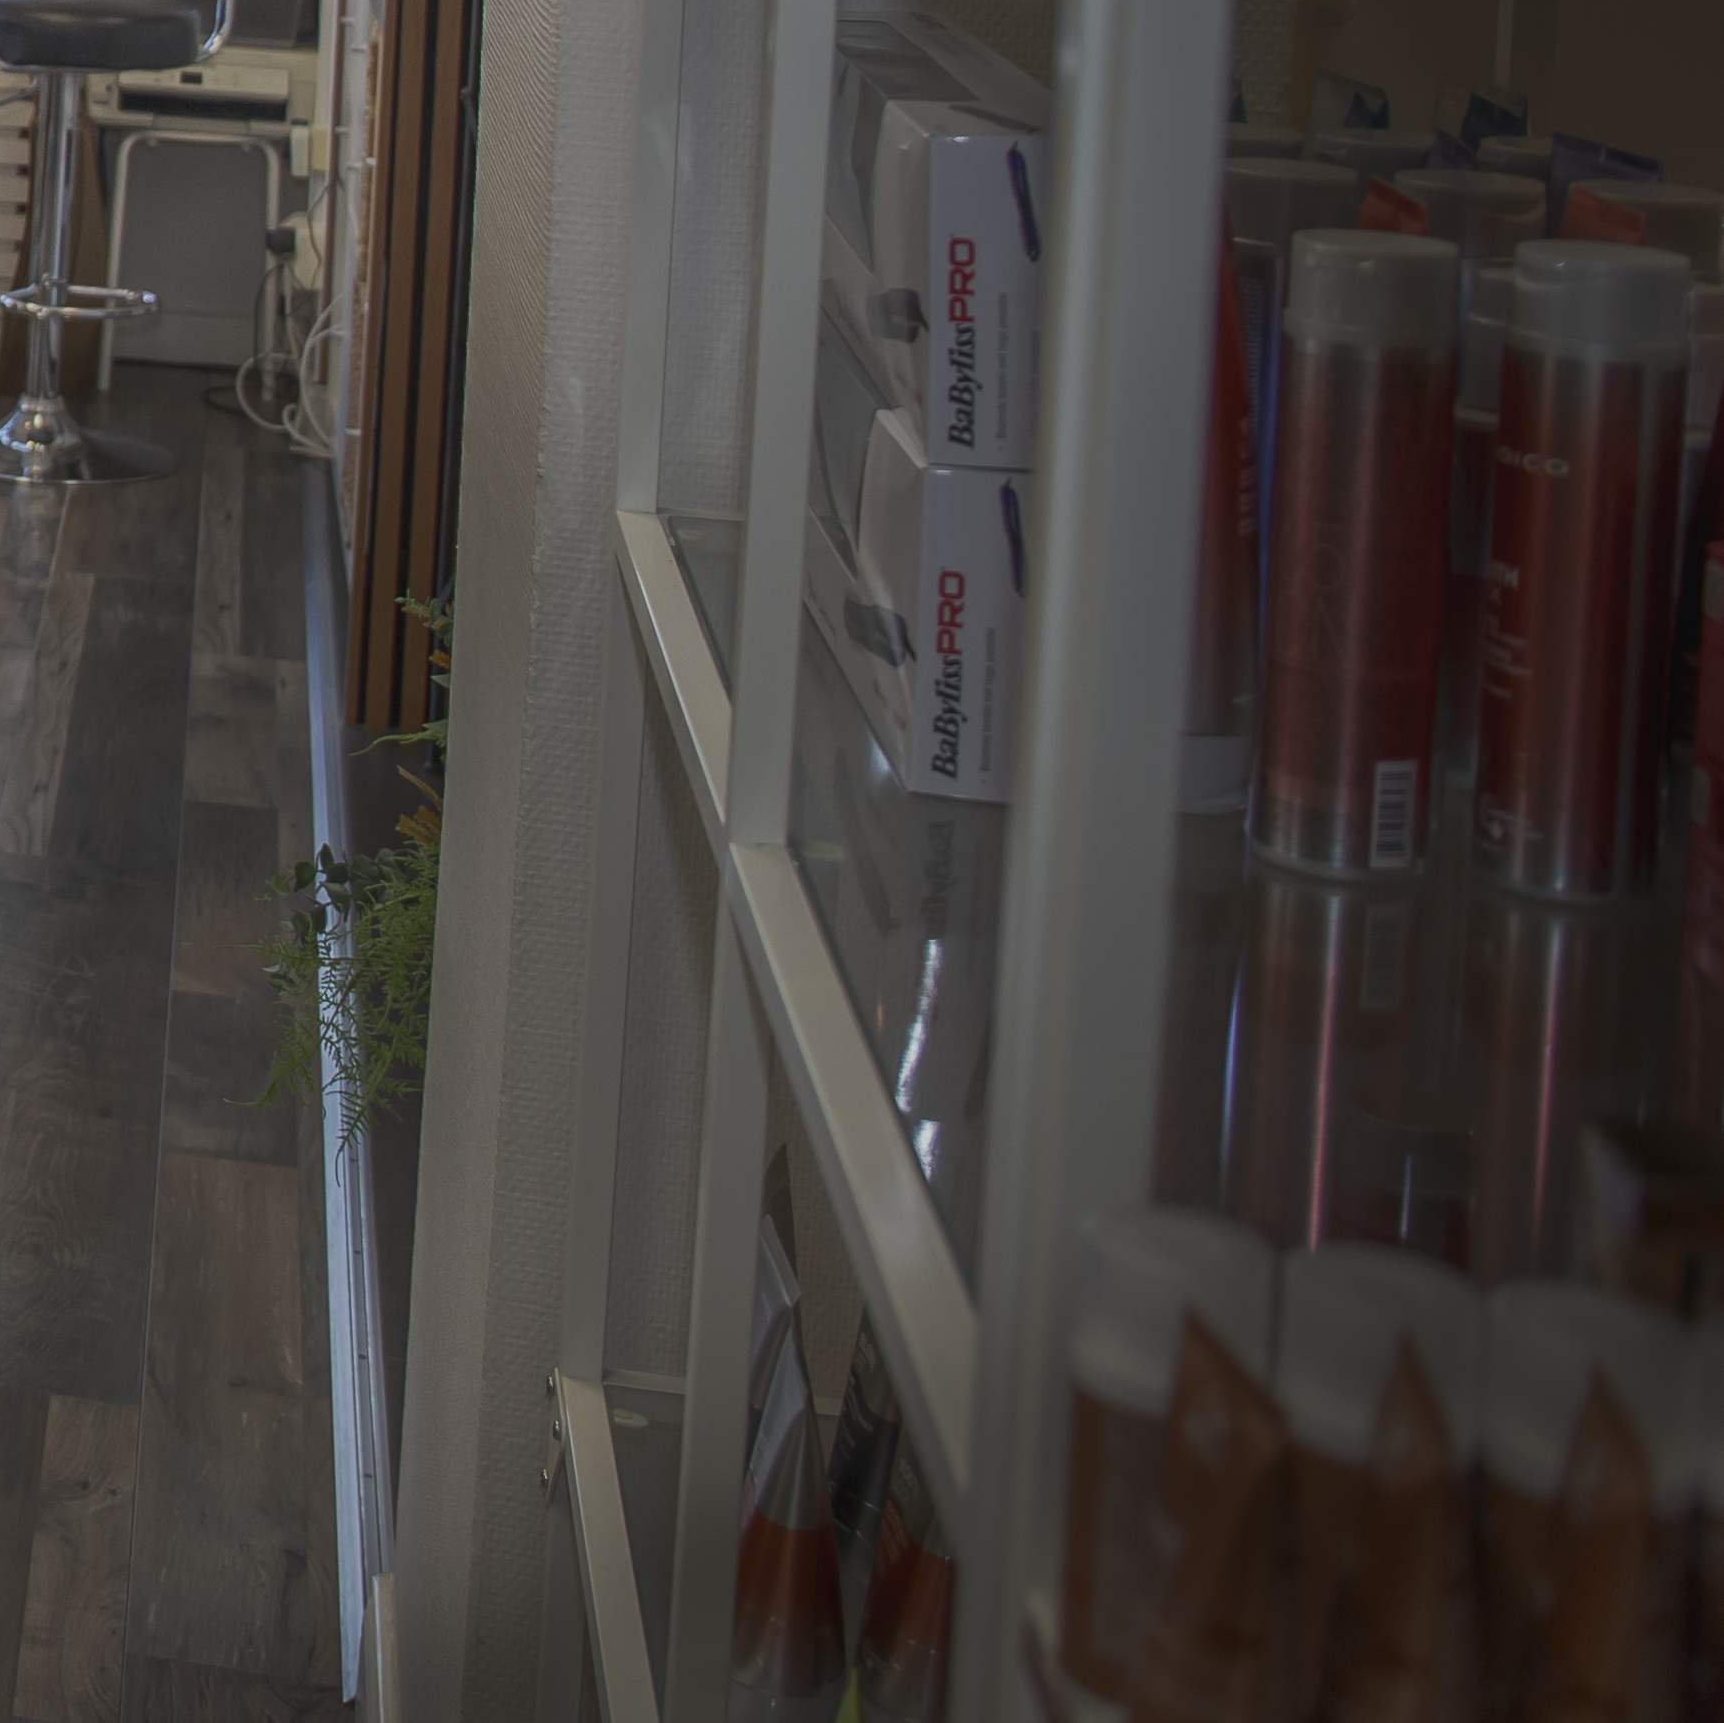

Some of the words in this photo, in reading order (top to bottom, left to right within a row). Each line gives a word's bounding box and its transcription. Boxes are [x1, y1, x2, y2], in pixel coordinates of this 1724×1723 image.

[947, 238, 983, 449] BaBylissPRO
[1496, 445, 1571, 478] OICO
[930, 570, 968, 780] BaBylissPRO
